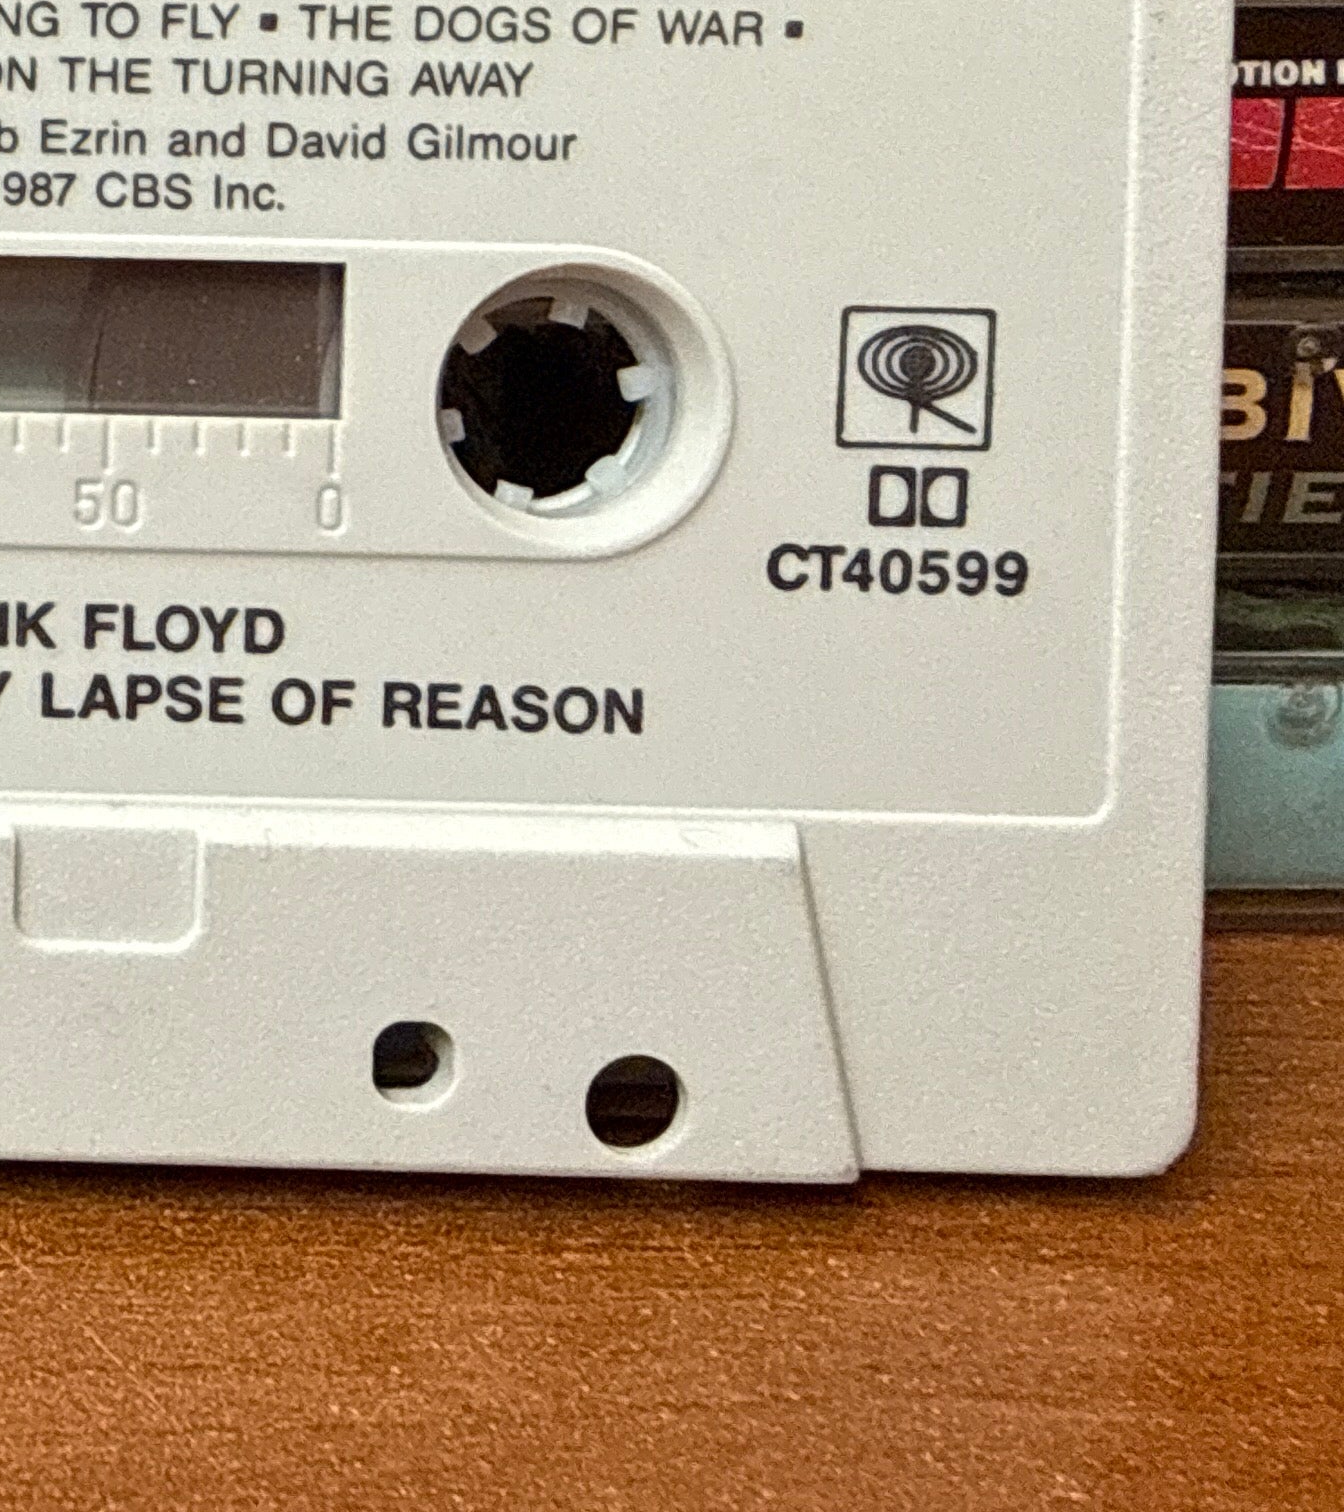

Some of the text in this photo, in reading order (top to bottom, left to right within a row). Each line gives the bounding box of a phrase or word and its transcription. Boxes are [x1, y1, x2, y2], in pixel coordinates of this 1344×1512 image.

[80, 1, 141, 40] TO
[160, 2, 240, 41] FLY
[298, 3, 393, 43] THE
[414, 5, 552, 45] DOGS
[571, 6, 638, 46] OF
[657, 9, 764, 47] WAR
[58, 56, 152, 95] THE
[172, 57, 389, 98] TURNING
[409, 61, 534, 98] AWAY
[40, 118, 147, 156] Ezrin
[167, 122, 246, 159] and
[266, 121, 387, 161] David
[407, 122, 578, 162] Gilmour
[95, 170, 193, 211] CBS
[213, 174, 285, 212] Inc.
[1219, 366, 1344, 442] BI
[72, 475, 142, 532] 50
[314, 482, 349, 538] 0
[1219, 471, 1344, 525] IE
[766, 542, 1029, 598] CT40599
[83, 603, 286, 655] FLOYD
[41, 671, 245, 725] LAPSE
[270, 677, 356, 727] OF
[382, 681, 644, 735] REASON
